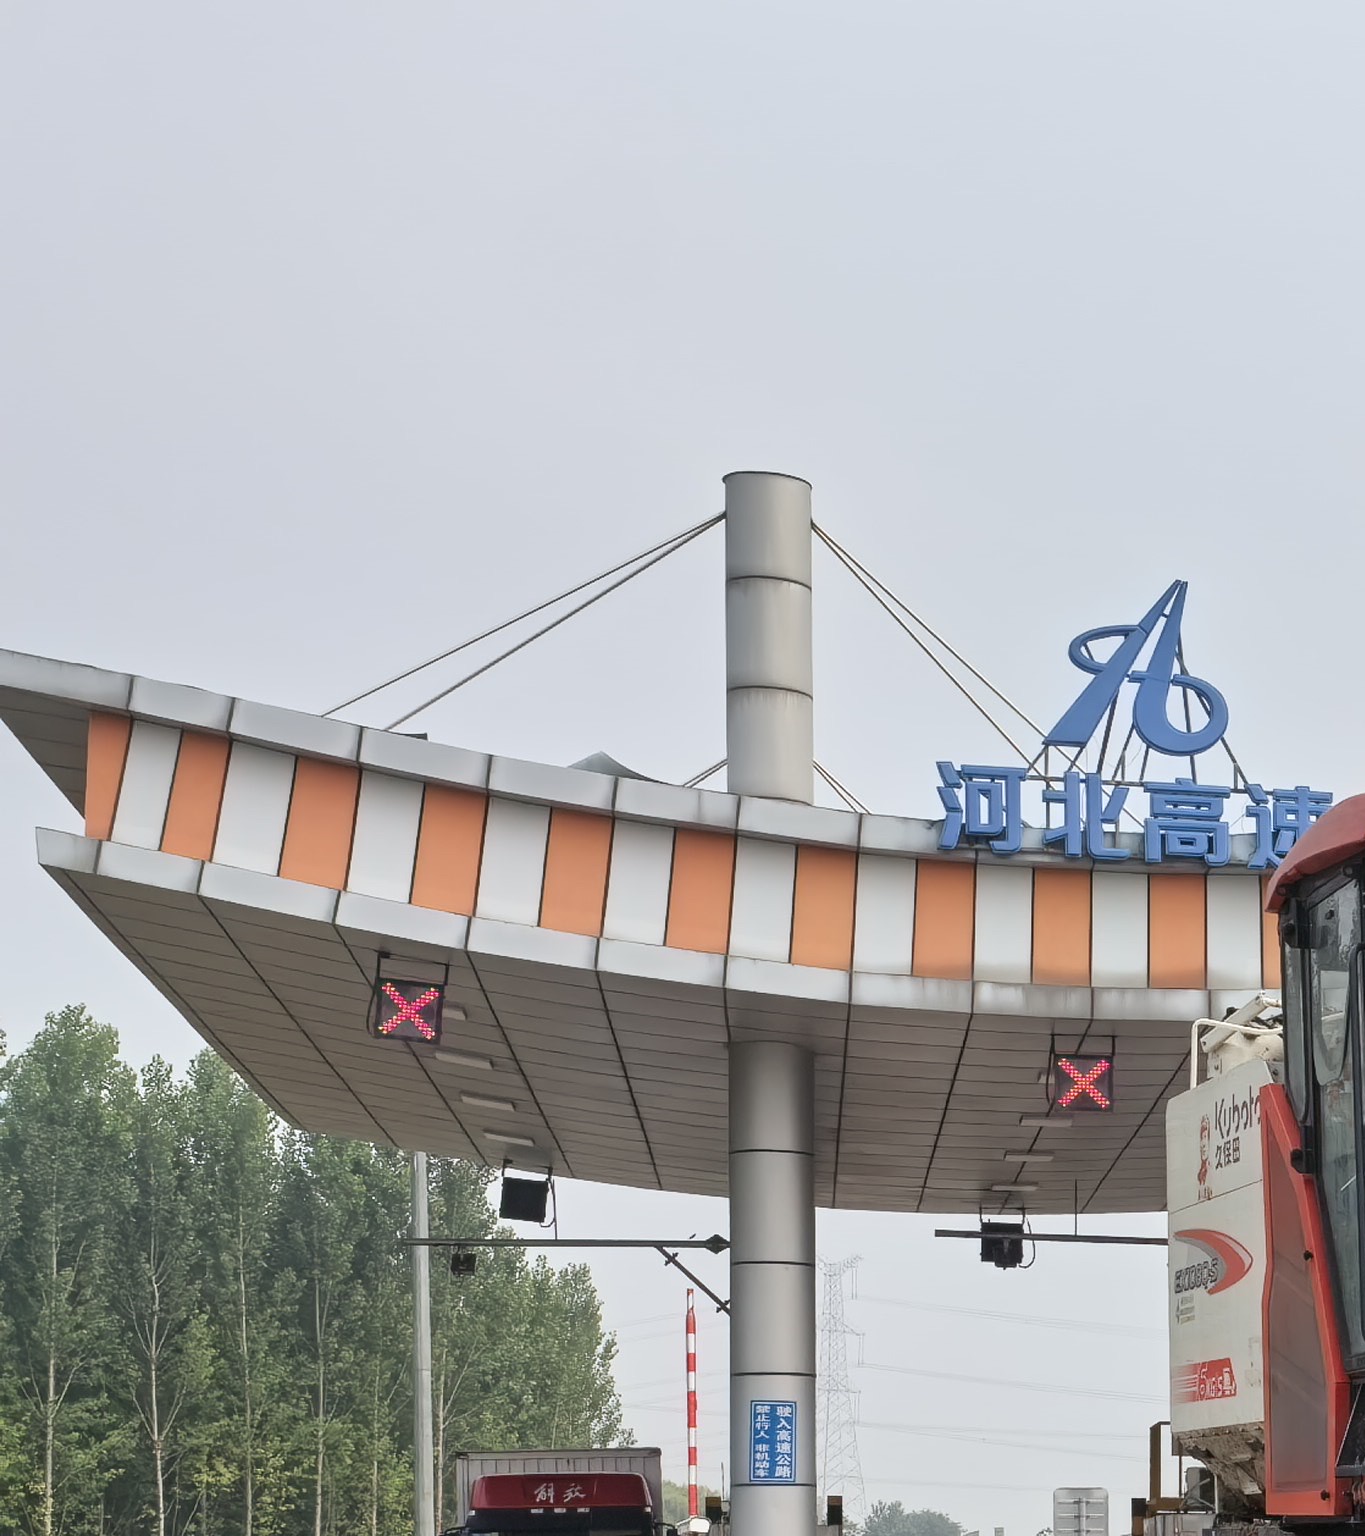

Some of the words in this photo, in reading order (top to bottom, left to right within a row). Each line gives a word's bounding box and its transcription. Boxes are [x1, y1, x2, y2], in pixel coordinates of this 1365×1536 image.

[935, 760, 1333, 869] 河北高速
[1215, 1136, 1241, 1170] 久保田
[774, 1405, 793, 1478] 驶入高速公路
